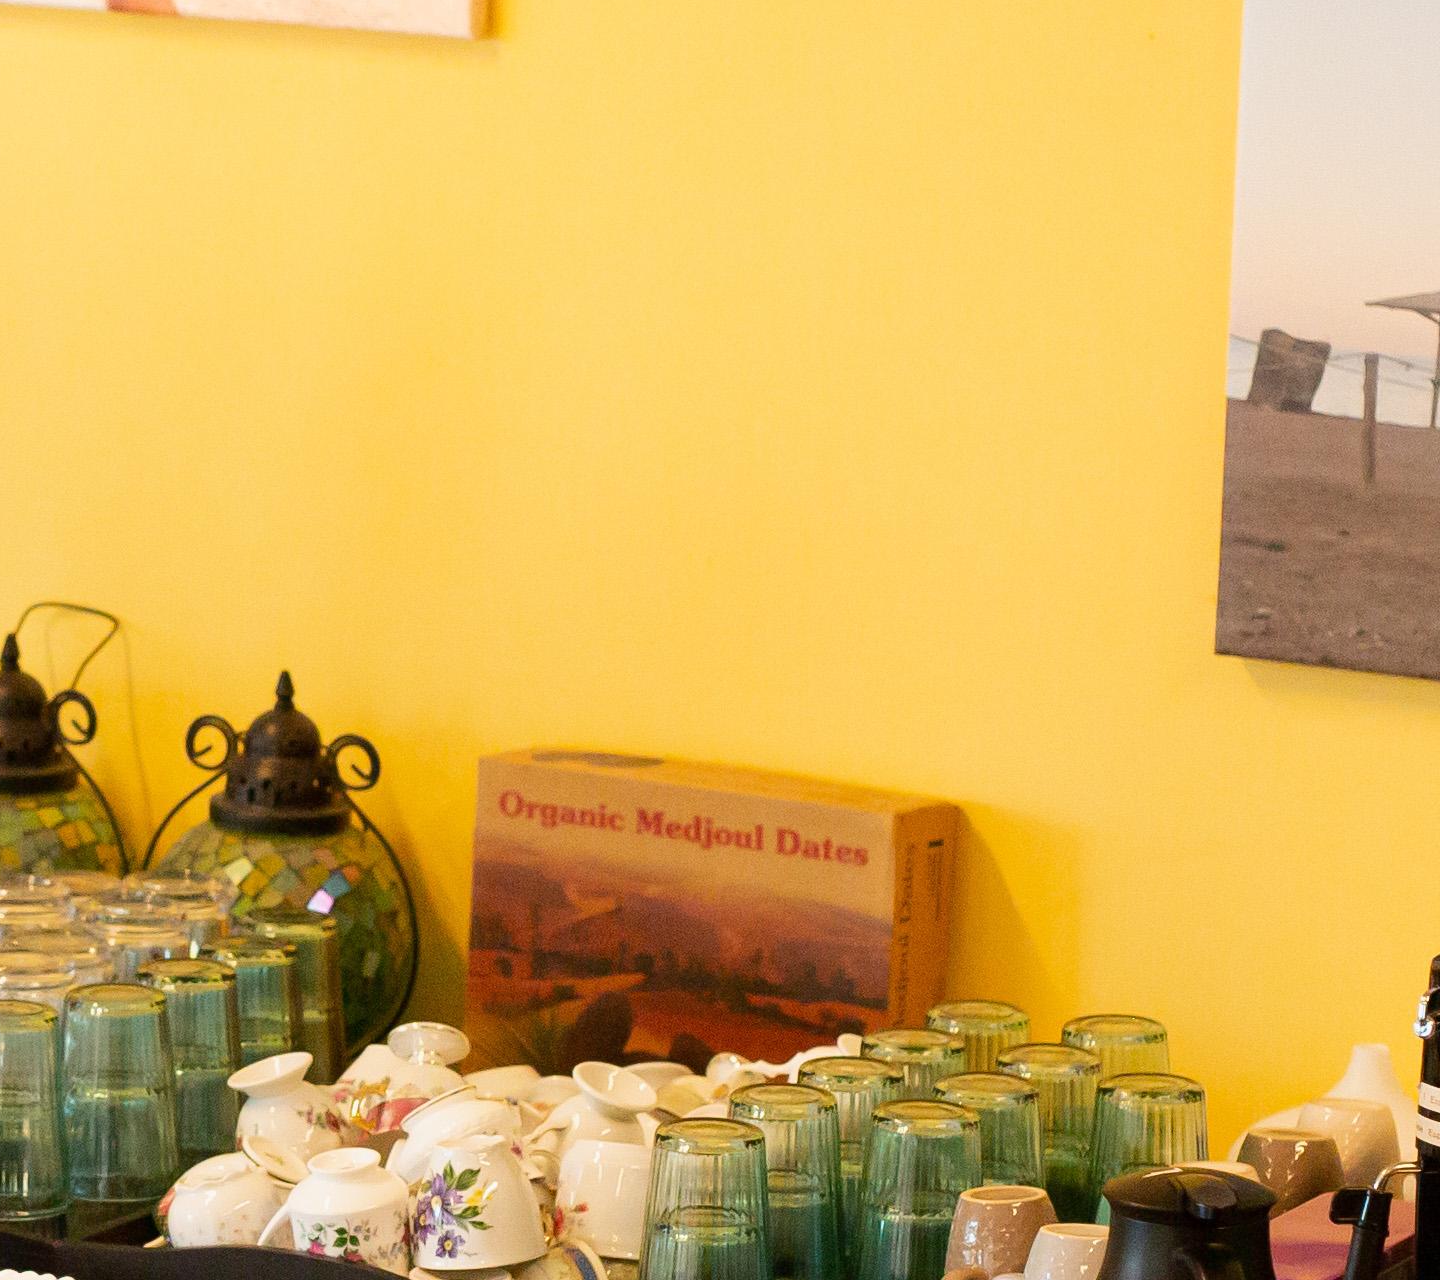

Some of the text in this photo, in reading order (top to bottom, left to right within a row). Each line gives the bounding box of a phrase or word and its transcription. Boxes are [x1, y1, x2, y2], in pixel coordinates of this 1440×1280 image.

[497, 789, 870, 866] Organic Medjoul Dates
